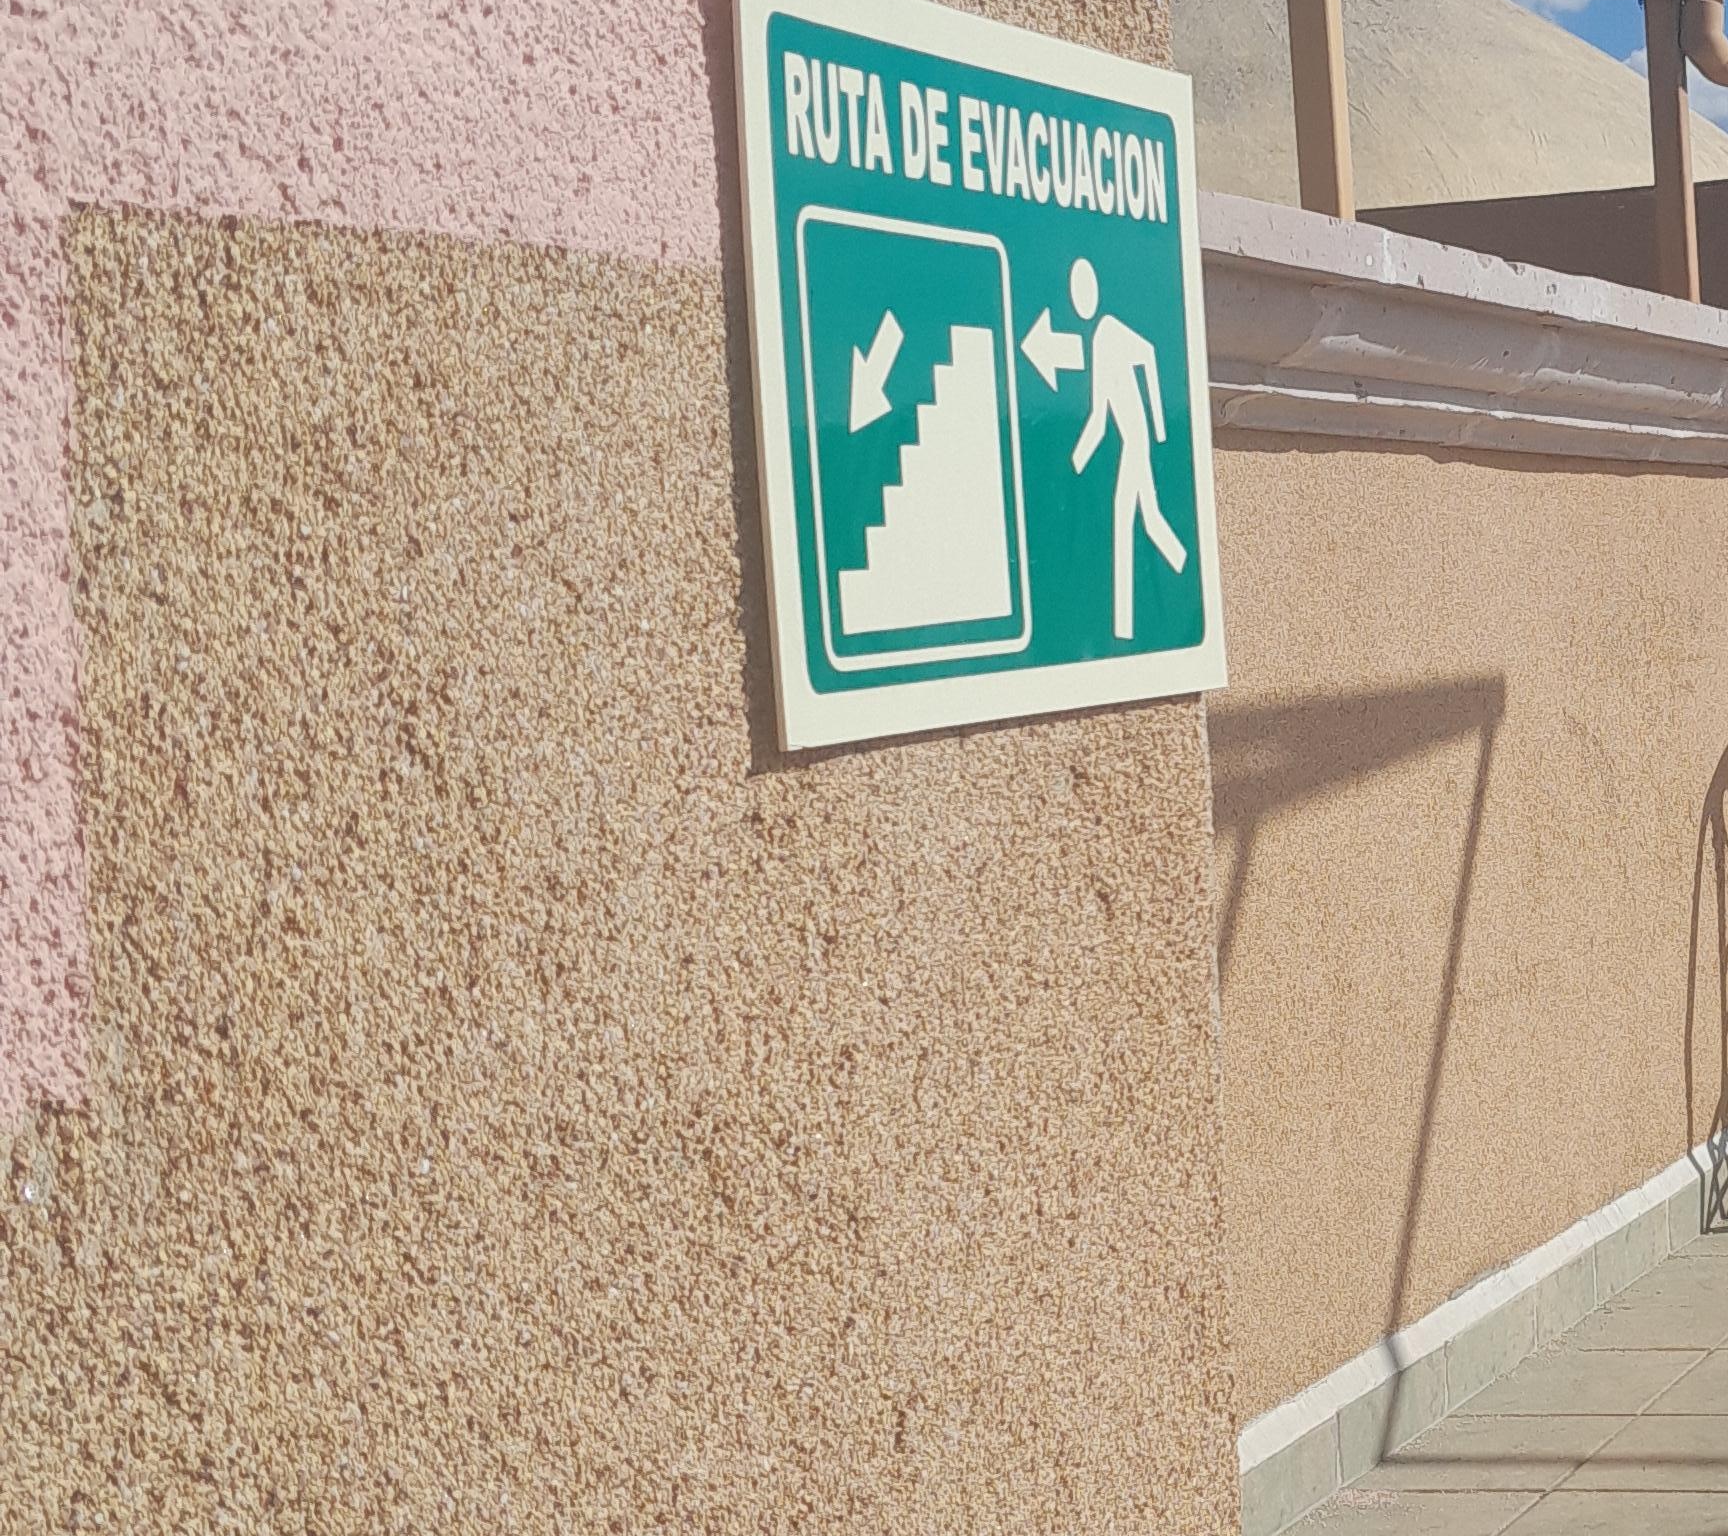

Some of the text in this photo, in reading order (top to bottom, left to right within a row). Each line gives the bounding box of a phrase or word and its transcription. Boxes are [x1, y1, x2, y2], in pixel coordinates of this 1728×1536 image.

[783, 50, 1169, 224] RUTA DE EVACUACION
